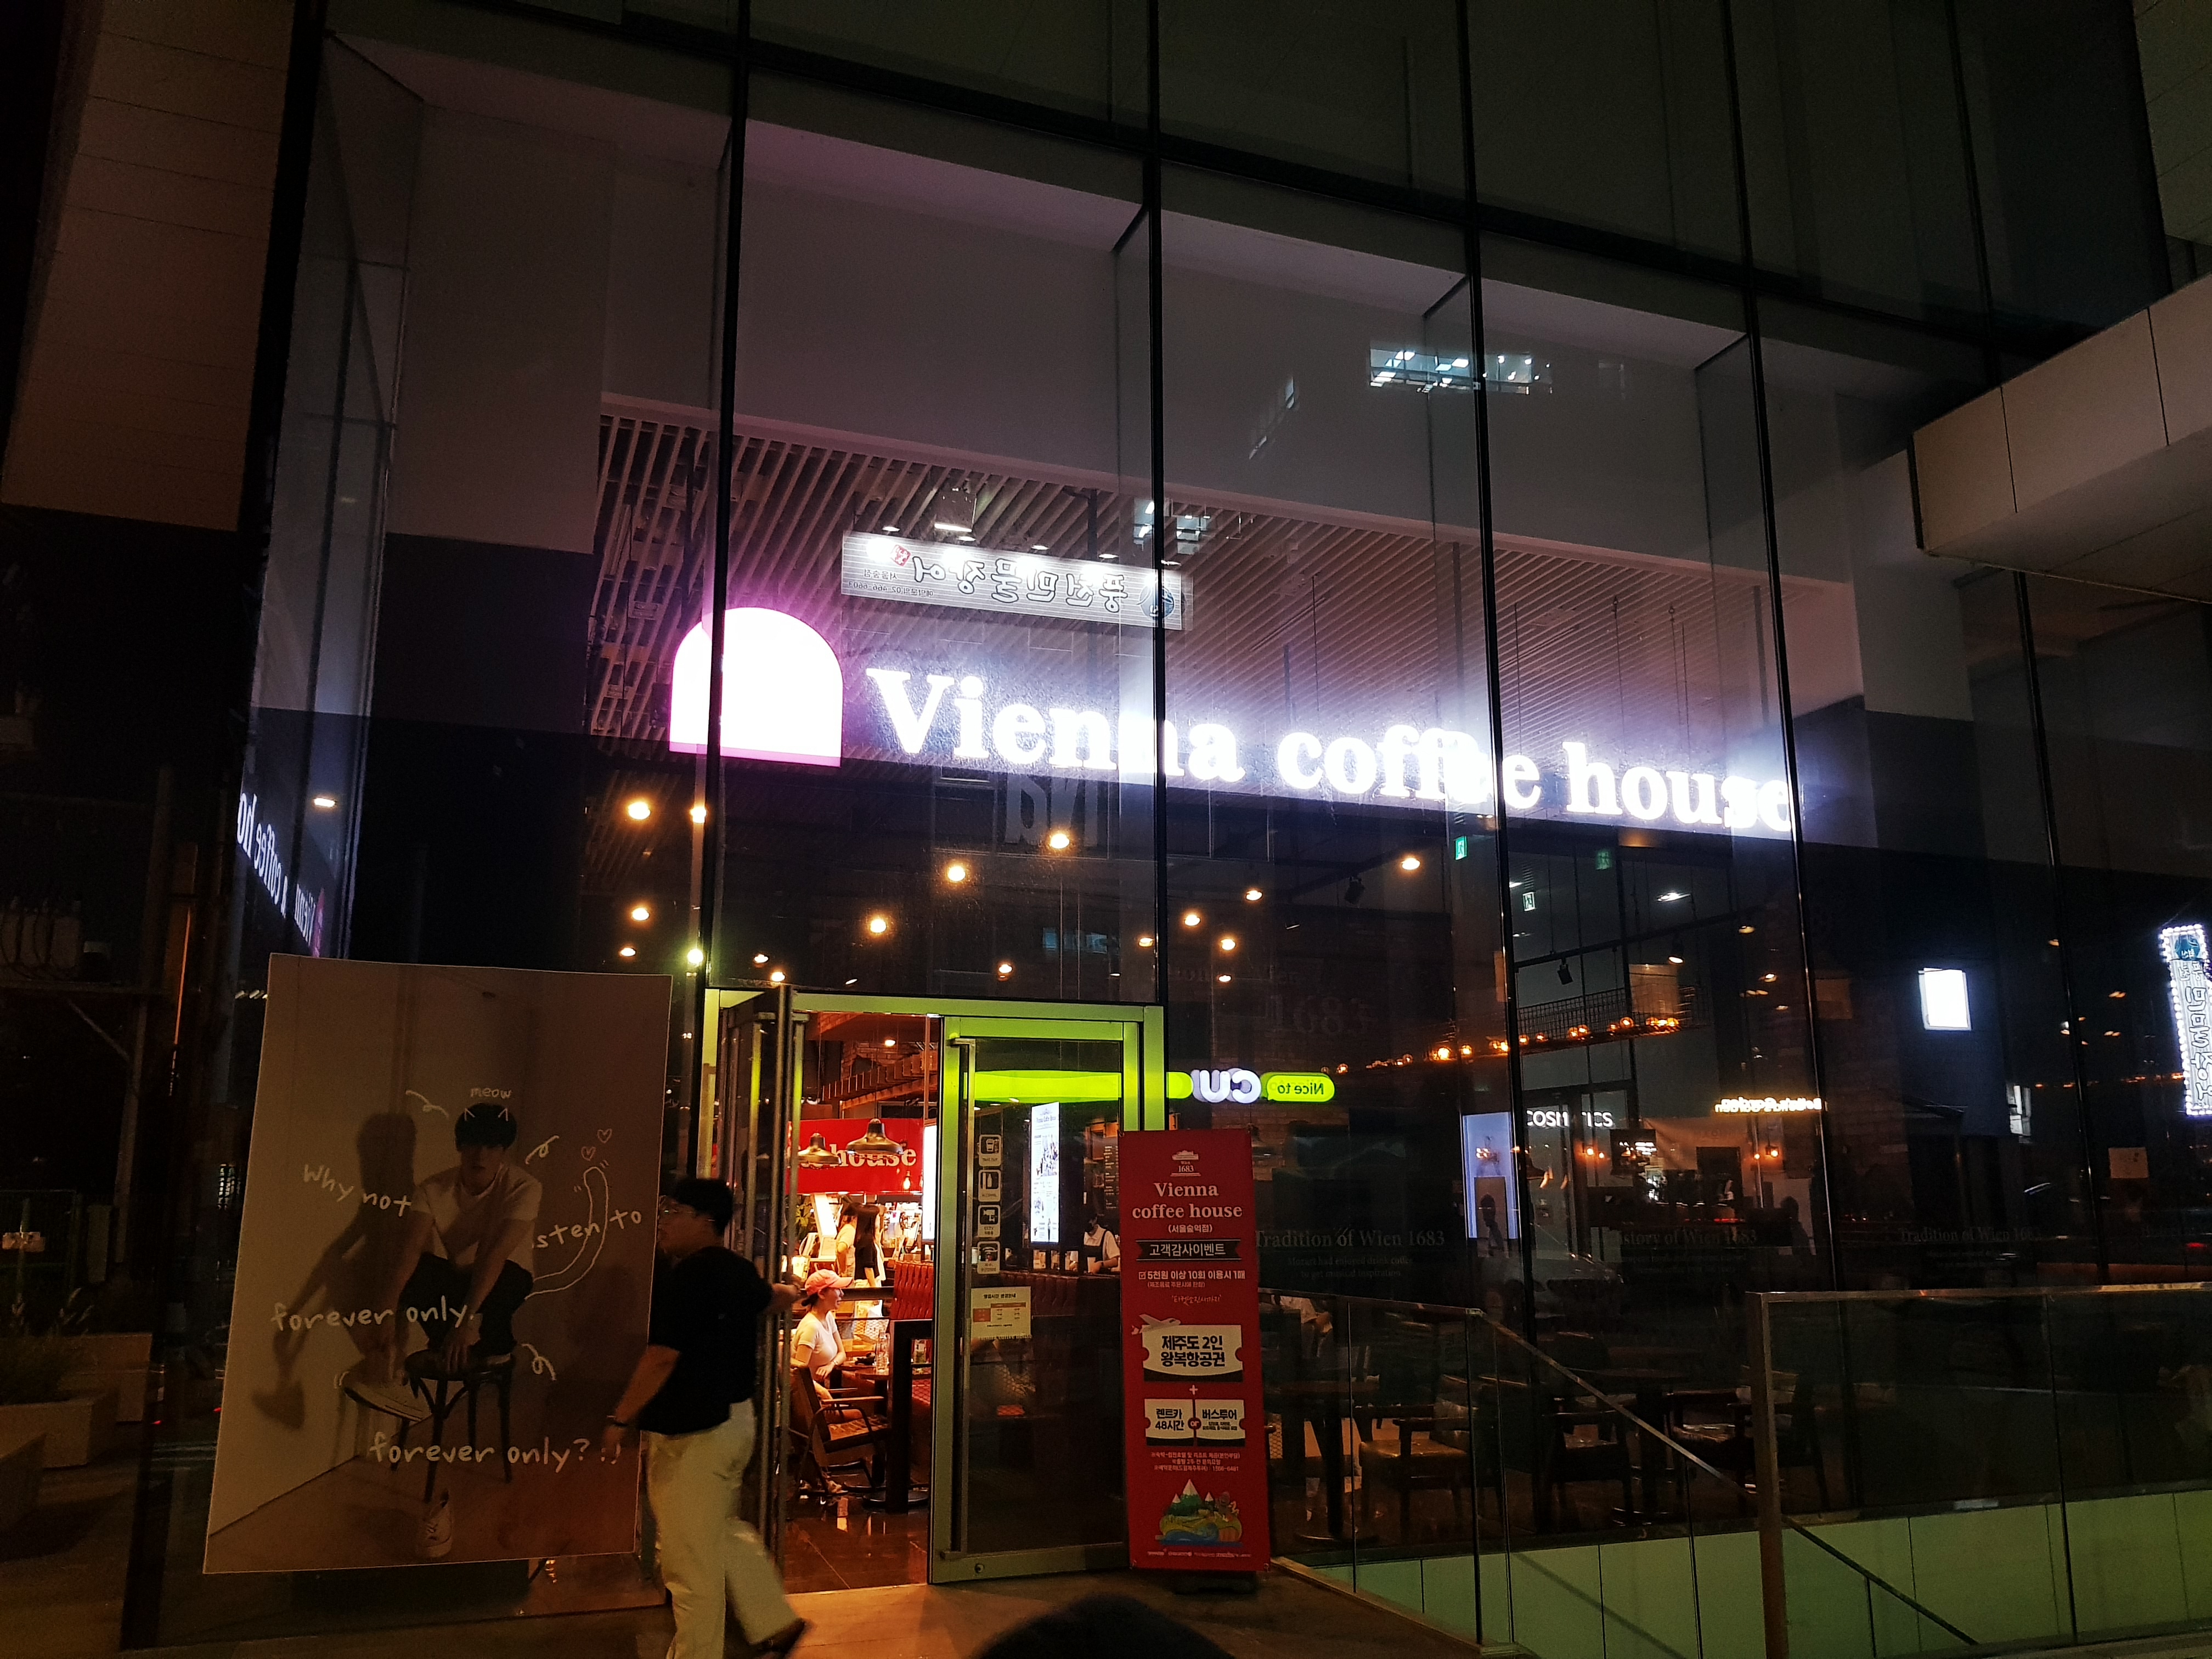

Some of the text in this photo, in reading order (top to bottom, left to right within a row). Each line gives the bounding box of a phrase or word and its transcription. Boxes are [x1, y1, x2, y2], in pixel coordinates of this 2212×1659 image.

[866, 668, 1794, 831] Vienna coffee house
[470, 1086, 512, 1099] meow
[303, 1165, 413, 1217] Why not
[1153, 1182, 1220, 1197] Vienna
[1132, 1203, 1243, 1218] coffee house
[609, 1208, 642, 1230] to
[1256, 1229, 1331, 1247] Tradition
[1408, 1230, 1446, 1246] 1683
[1149, 1243, 1226, 1257] 고객감사이벤트
[1147, 1270, 1246, 1280] 5천원 이상 10회 이용시 1매
[270, 1303, 394, 1331] forever
[1161, 1335, 1223, 1351] 제주도 2인
[1161, 1352, 1225, 1367] 왕복항공권
[1155, 1408, 1182, 1419] 렌트카
[1202, 1409, 1237, 1420] 버스투어
[1155, 1420, 1184, 1431] 48시간
[369, 1432, 495, 1464] forever
[507, 1437, 590, 1472] only?
